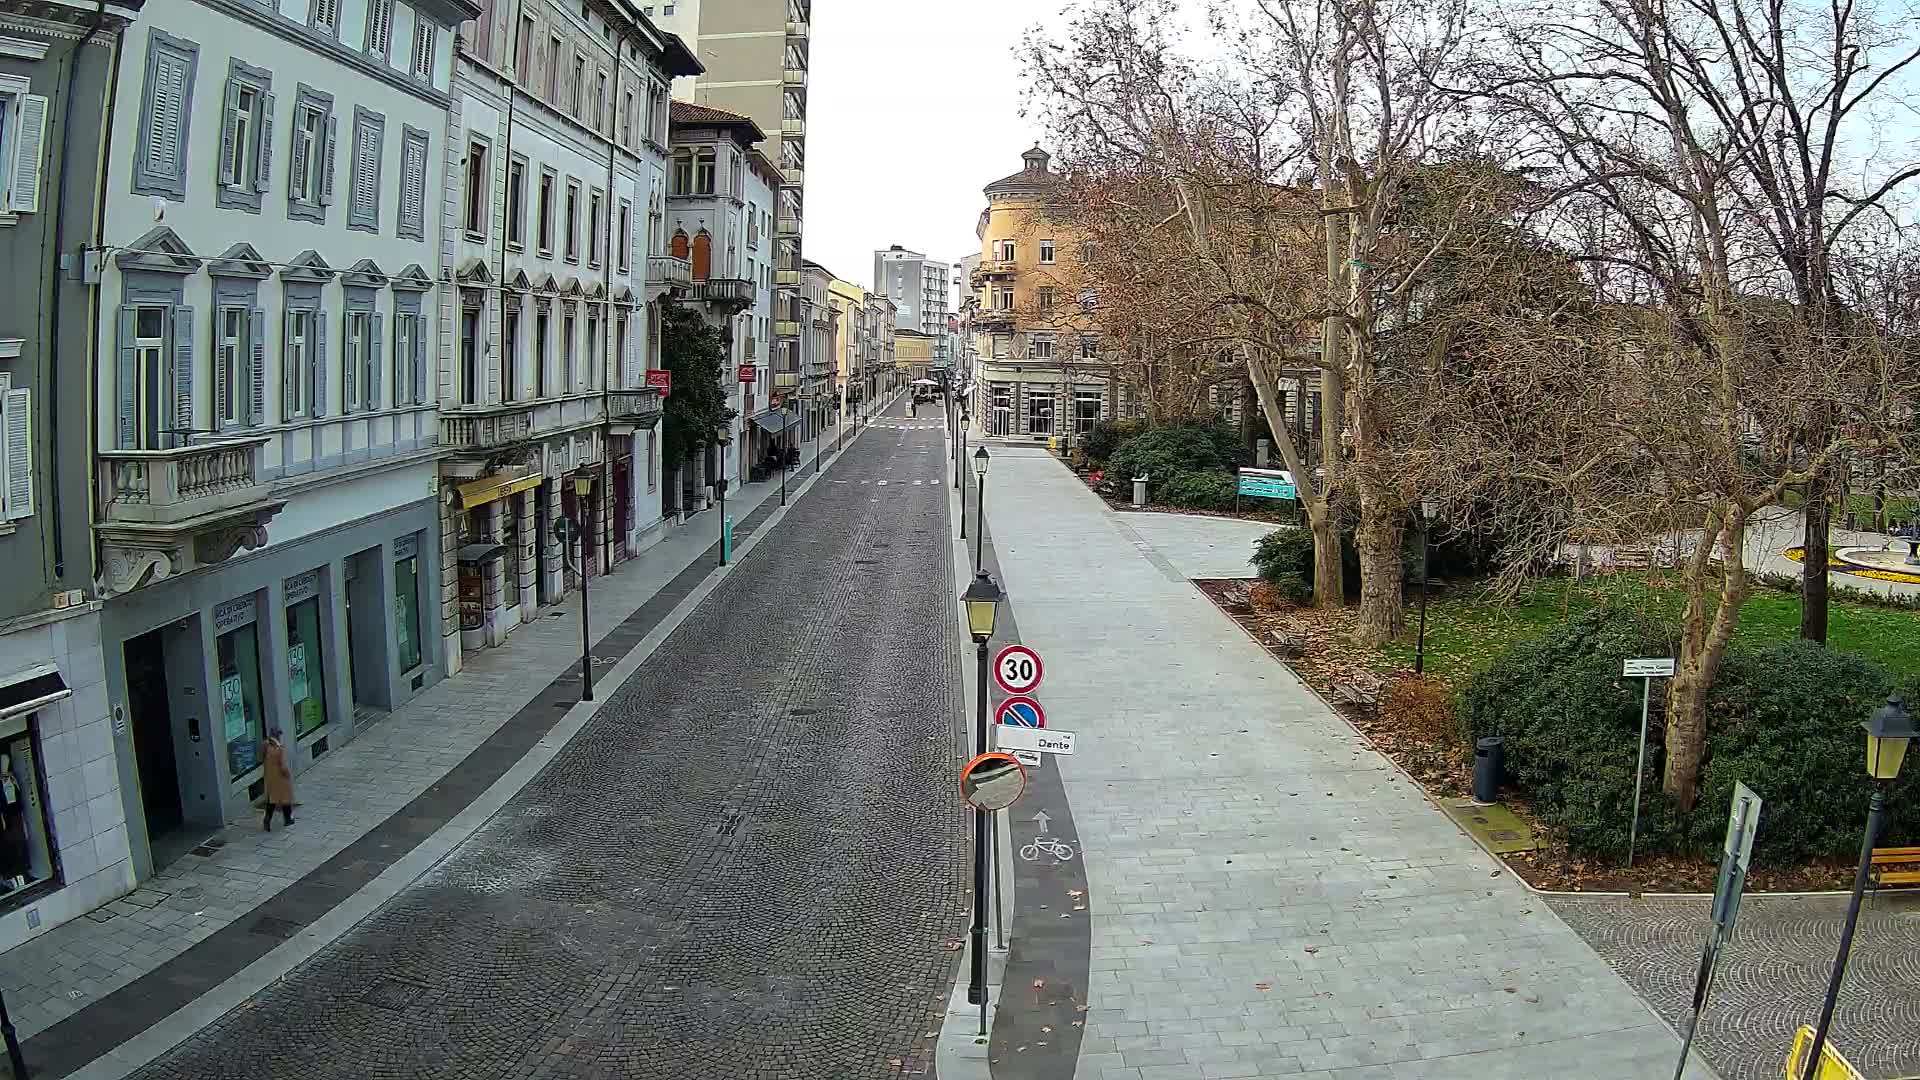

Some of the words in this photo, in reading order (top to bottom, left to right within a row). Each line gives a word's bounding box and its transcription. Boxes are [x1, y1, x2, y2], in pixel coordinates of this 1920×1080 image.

[1005, 659, 1032, 681] 30
[222, 679, 240, 701] 130
[1038, 739, 1070, 750] Dante
